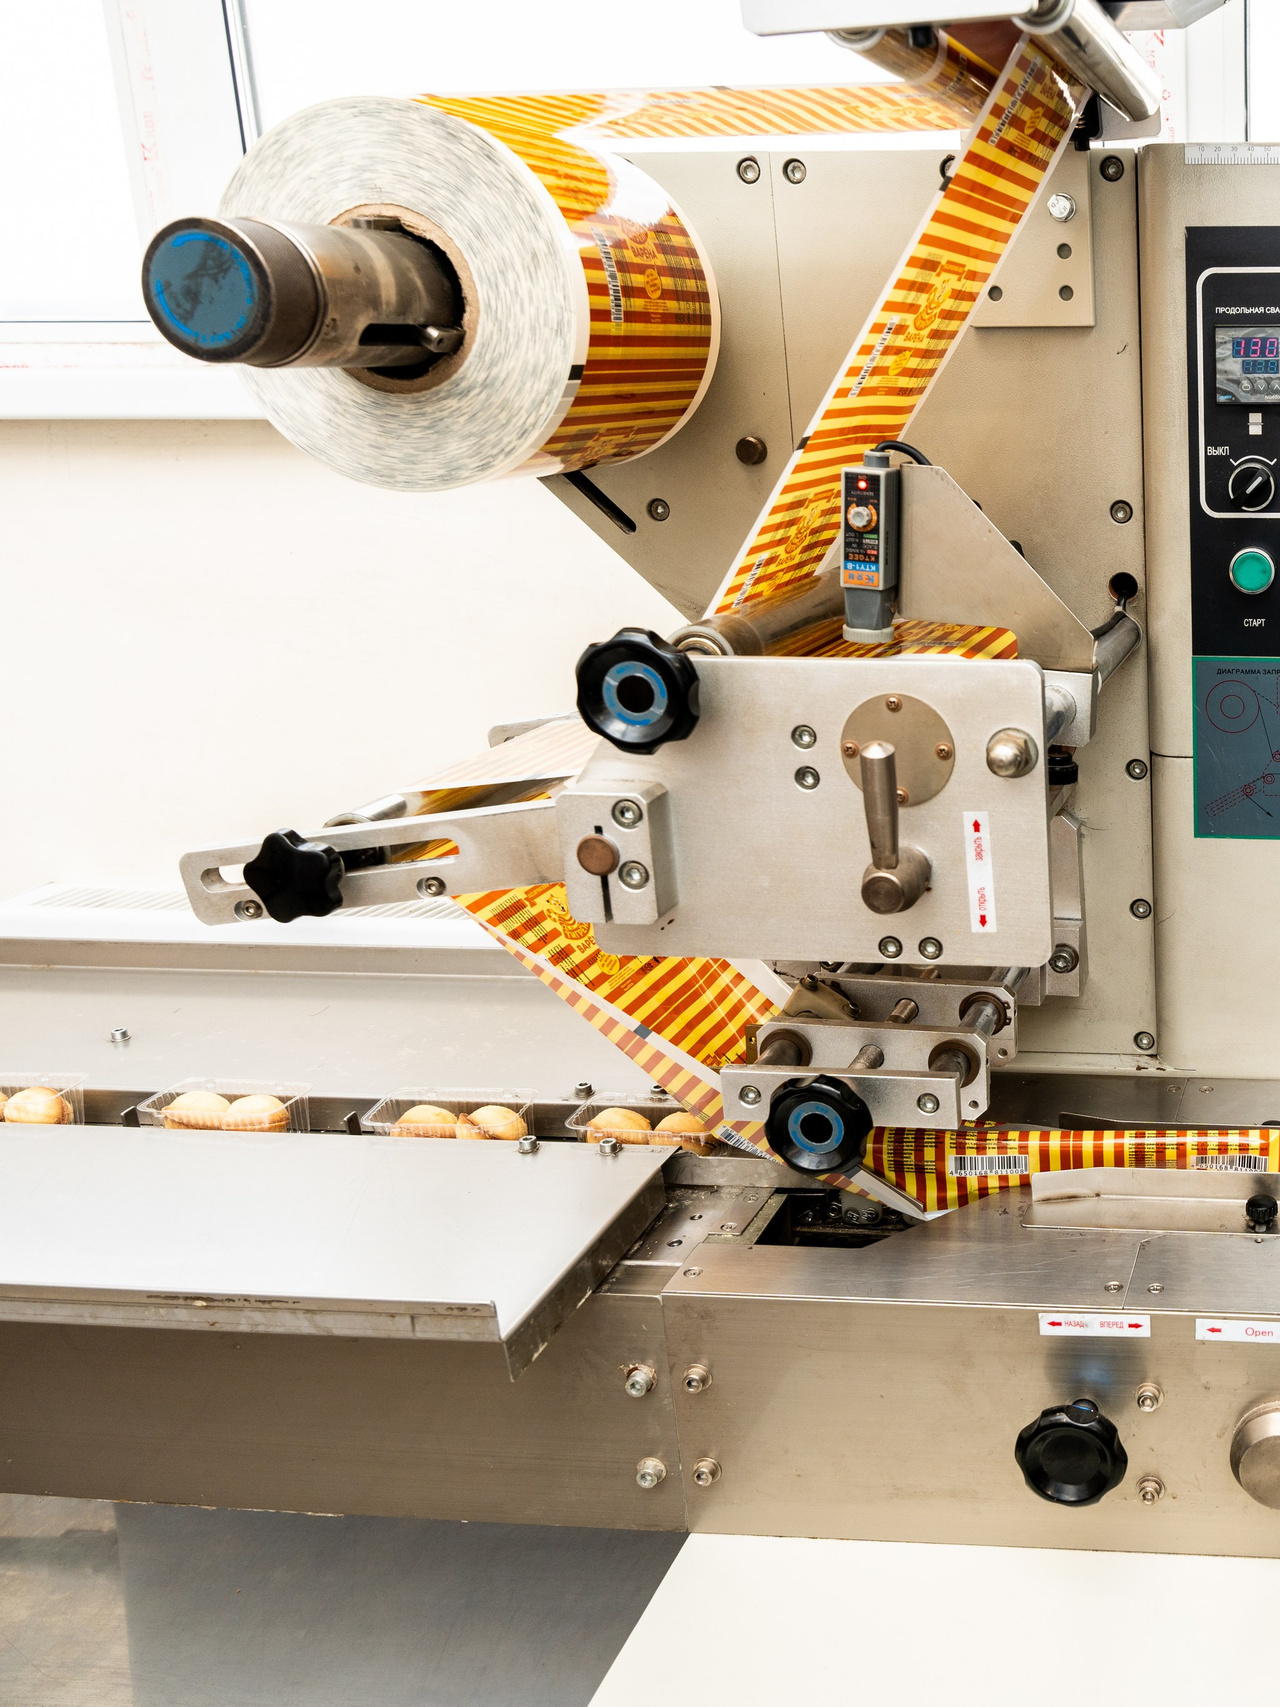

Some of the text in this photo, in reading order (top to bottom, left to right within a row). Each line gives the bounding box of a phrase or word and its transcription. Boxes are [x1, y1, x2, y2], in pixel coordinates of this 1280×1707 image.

[1240, 338, 1278, 357] 130
[1207, 446, 1229, 456] ВЫКЛ
[1243, 619, 1265, 627] СТАРТ
[978, 887, 987, 911] открыть
[1064, 1320, 1124, 1329] НАЗАД ВПЕРЕД
[1245, 1327, 1273, 1337] Open
